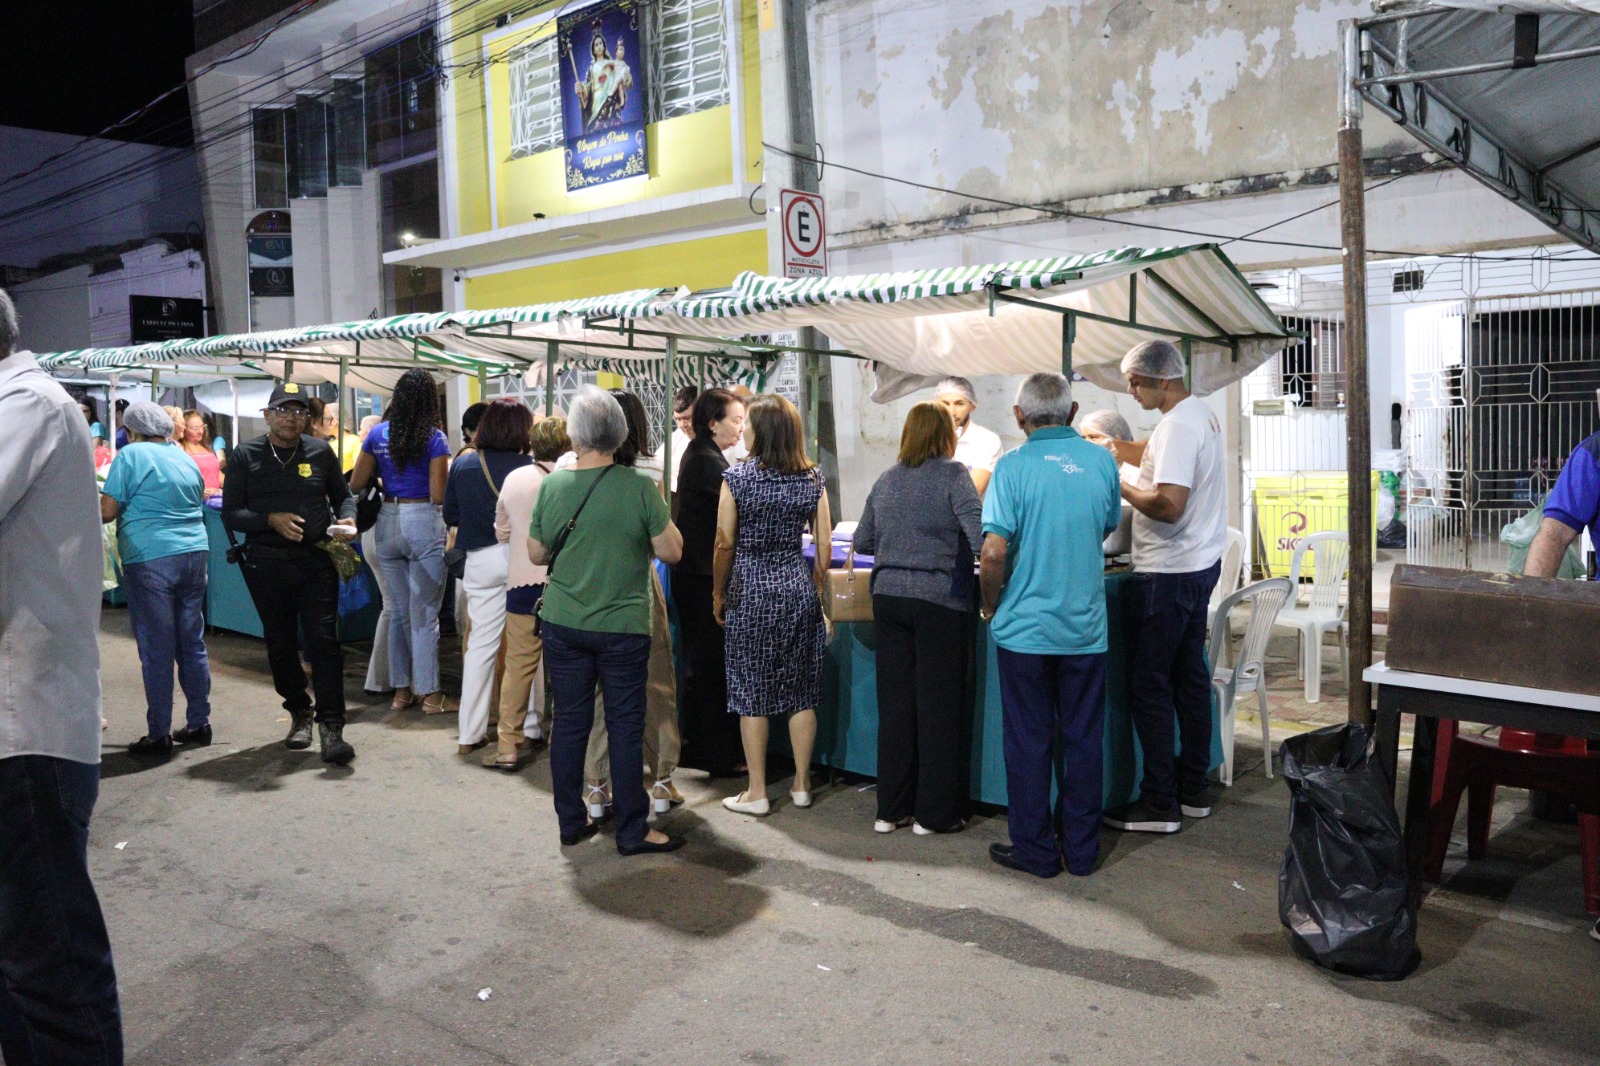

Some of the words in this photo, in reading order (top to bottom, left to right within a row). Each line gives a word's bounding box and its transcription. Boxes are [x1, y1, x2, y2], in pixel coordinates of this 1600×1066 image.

[798, 210, 811, 243] E
[789, 266, 806, 275] ZONA
[808, 268, 823, 277] AZUL
